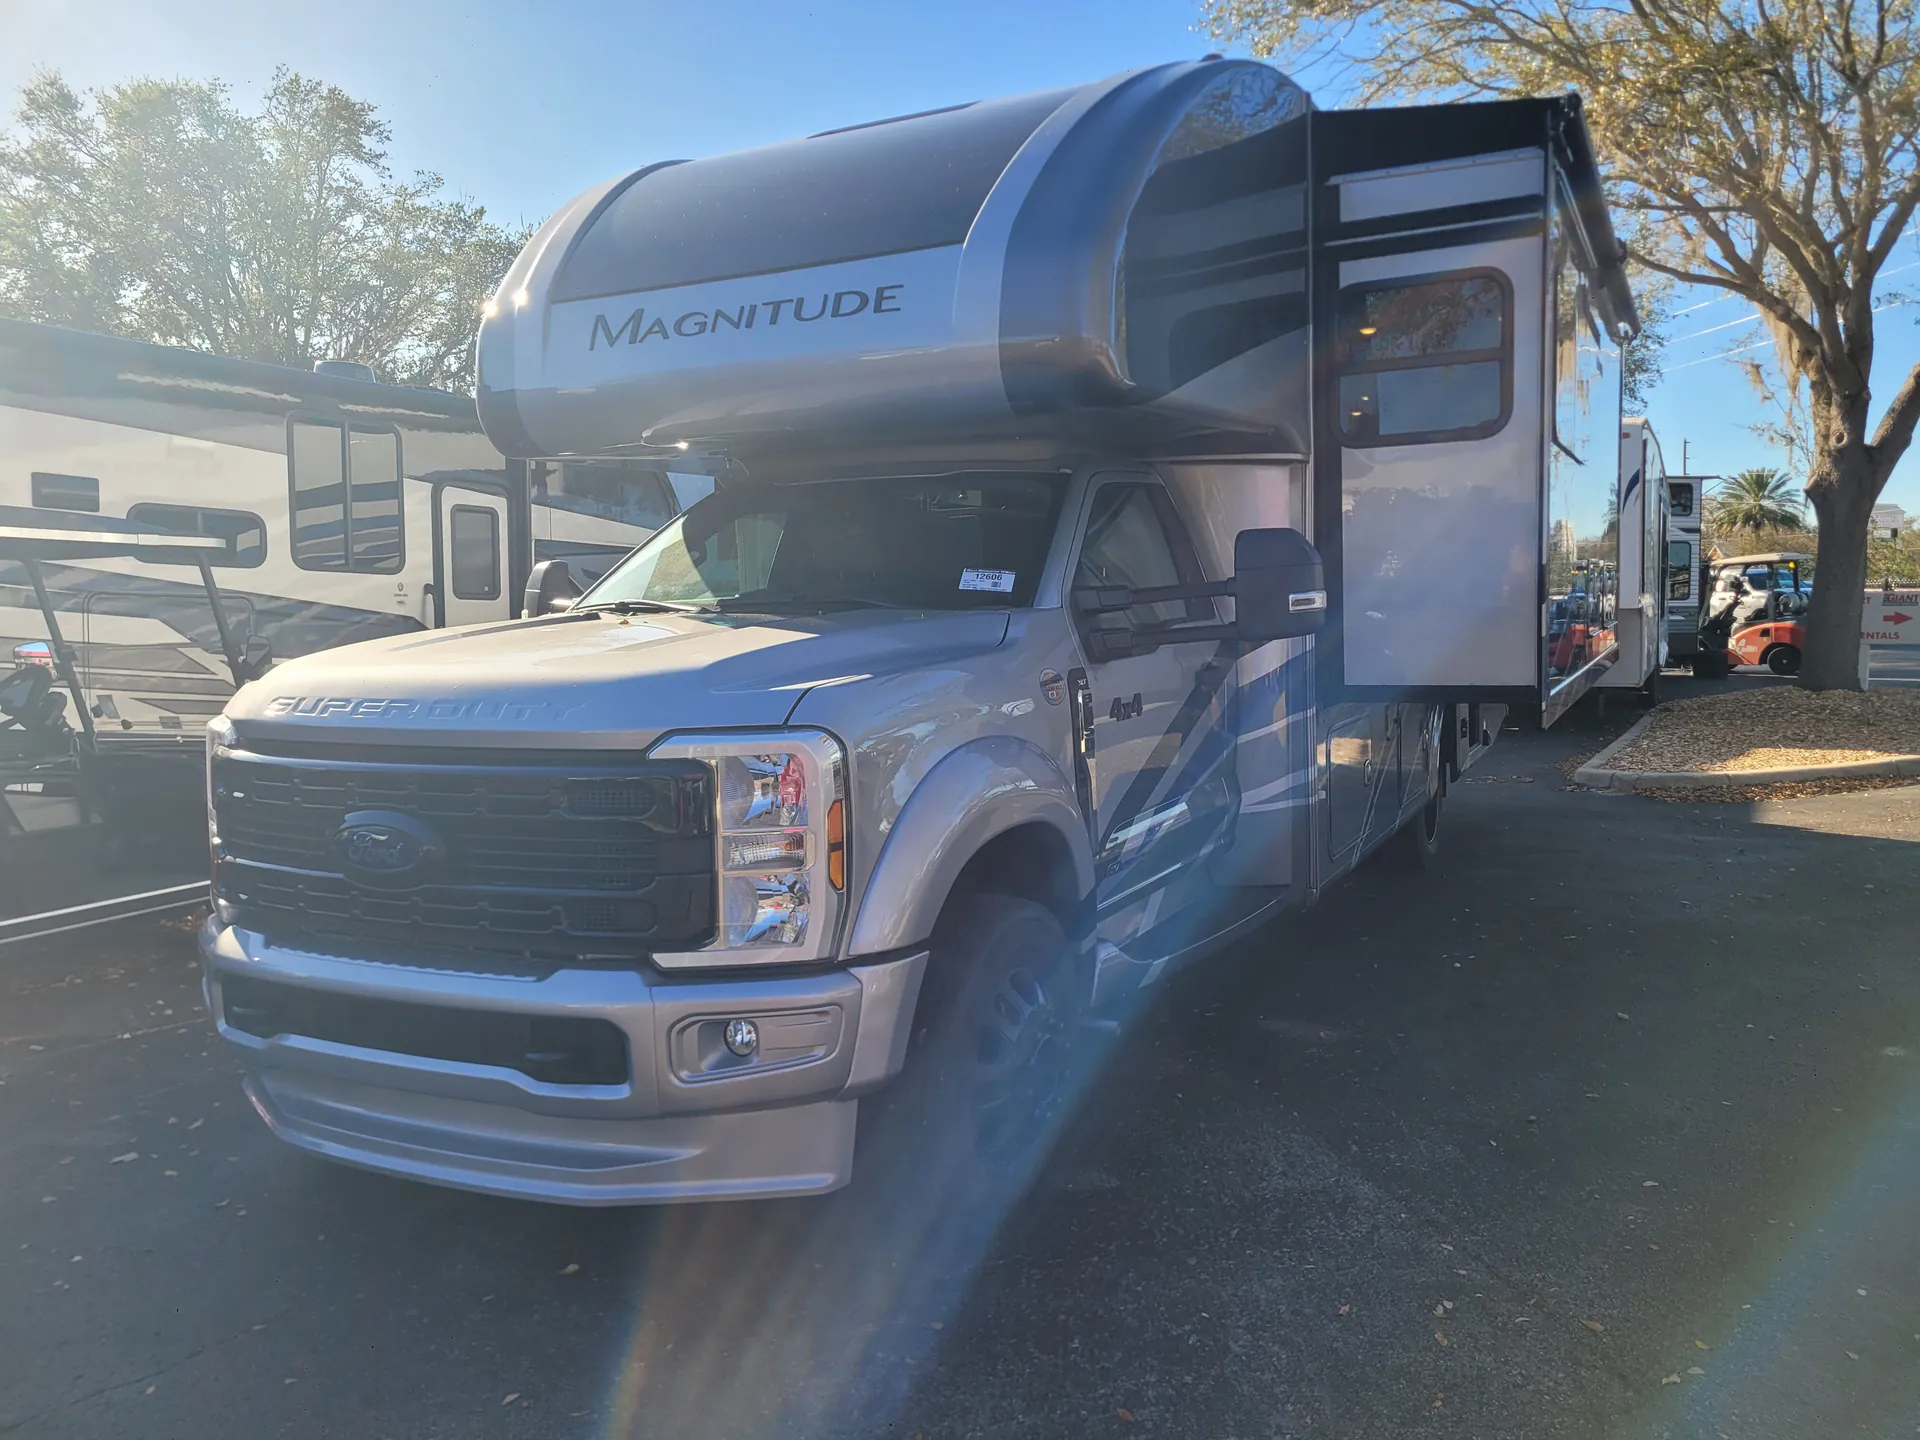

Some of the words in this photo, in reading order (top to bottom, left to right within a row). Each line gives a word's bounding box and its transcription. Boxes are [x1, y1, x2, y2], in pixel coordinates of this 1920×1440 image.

[588, 284, 905, 351] MAGNITUDE
[975, 573, 1003, 581] 12606
[1888, 593, 1918, 603] GIANT
[1861, 632, 1899, 640] ENTALS
[266, 695, 420, 719] SUPER
[427, 699, 587, 721] DUTY
[1109, 692, 1143, 722] 4x4
[348, 831, 406, 865] Ford
